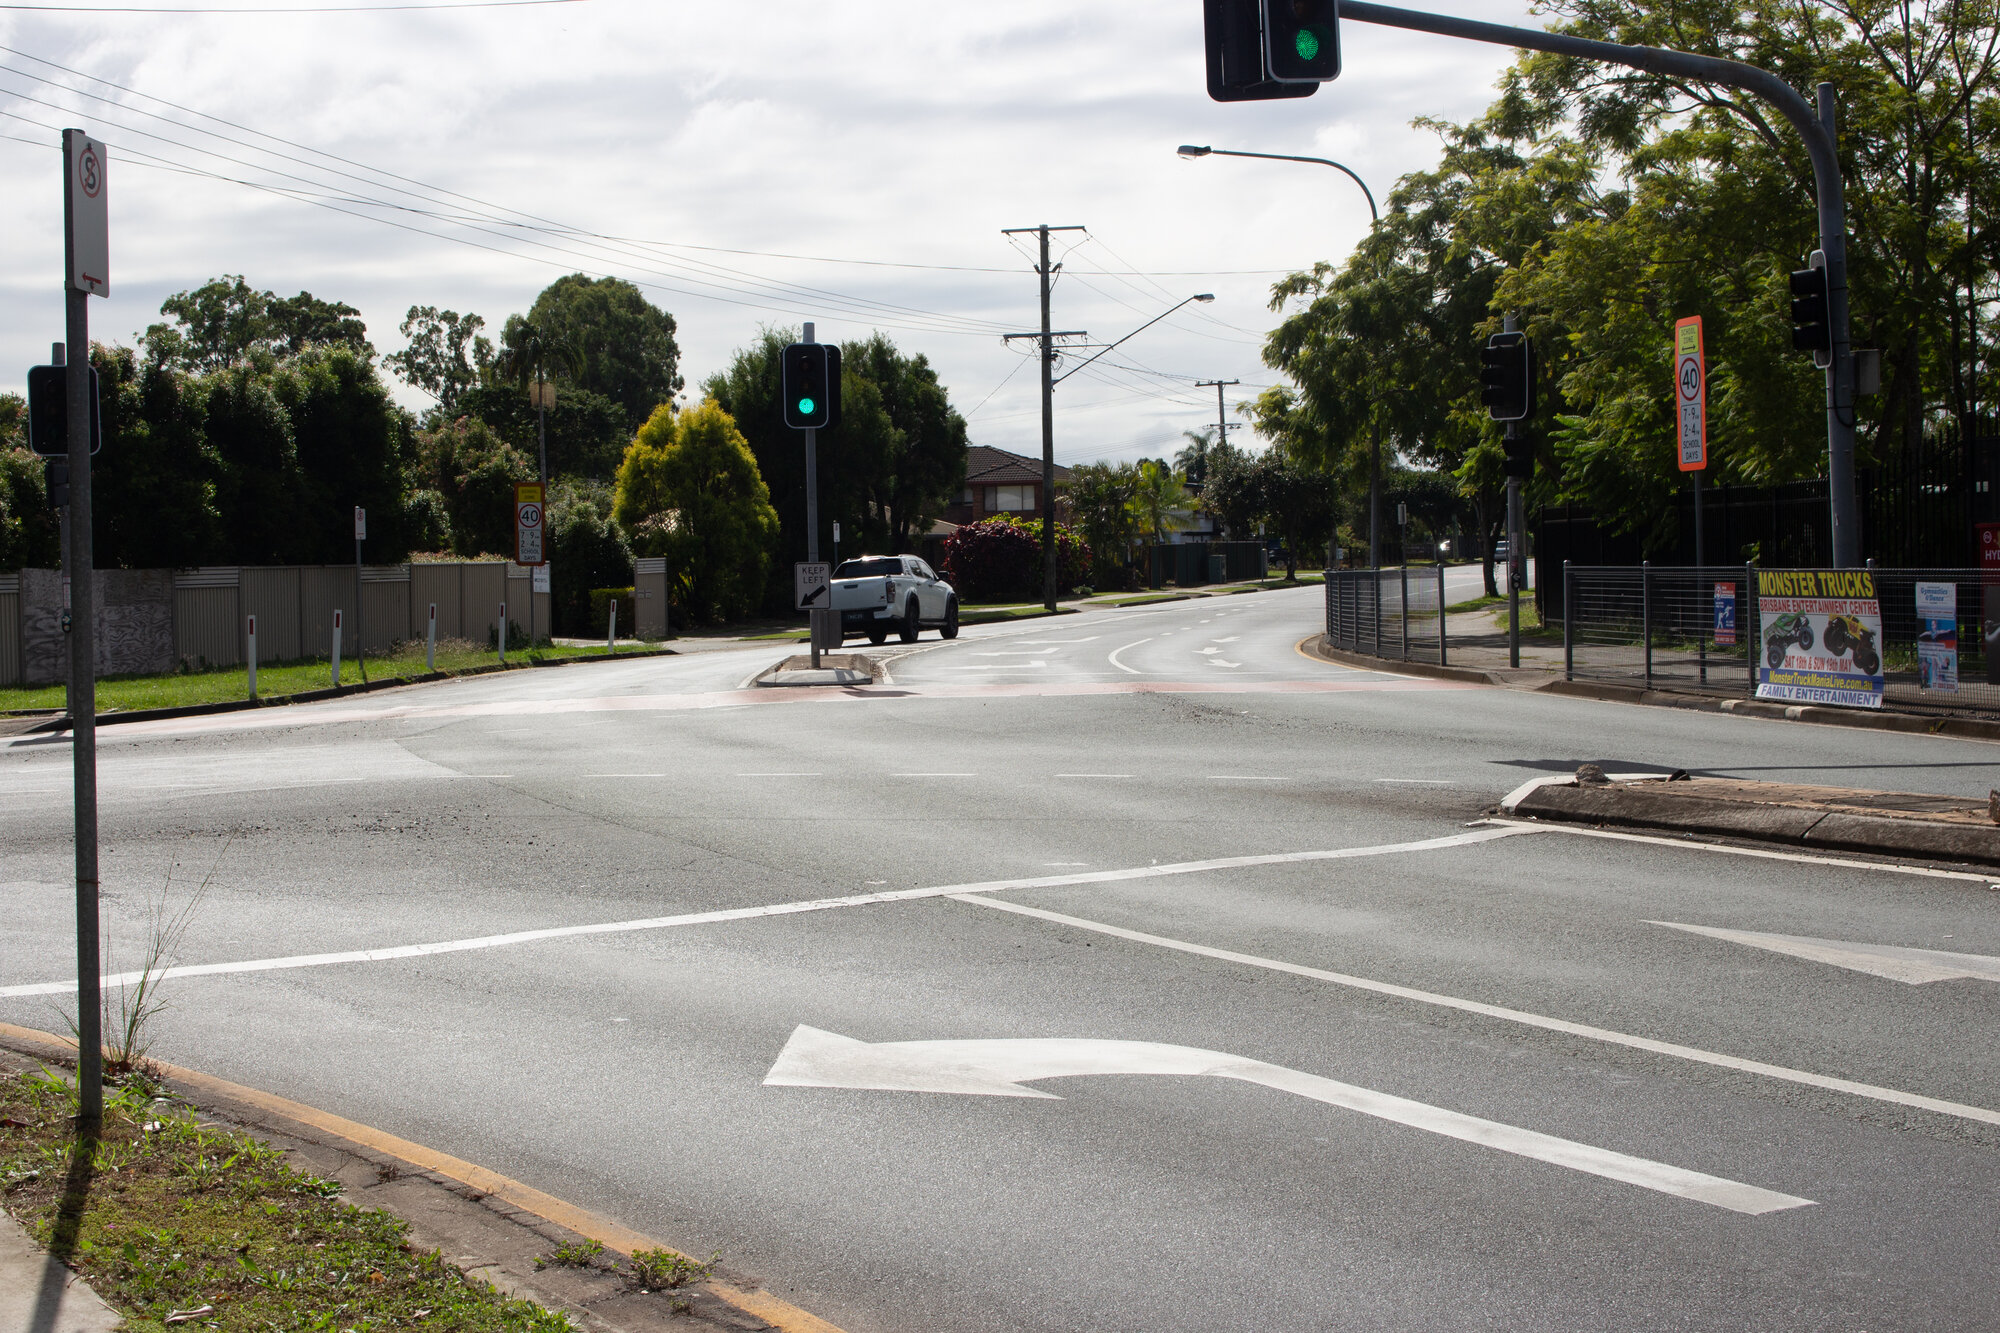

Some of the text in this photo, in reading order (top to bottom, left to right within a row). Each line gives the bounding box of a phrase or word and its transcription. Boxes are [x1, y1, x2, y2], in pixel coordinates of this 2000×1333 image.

[1682, 368, 1697, 390] 40
[1683, 440, 1700, 449] SCHOOL
[1686, 451, 1698, 460] DAYS
[521, 510, 538, 522] 40
[802, 566, 824, 575] KEEP
[803, 576, 824, 584] LEFT
[1759, 571, 1874, 597] MONSTER TRUCKS
[1760, 599, 1879, 615] BRISBANE ENTERTAINMENT CENTRE
[1784, 655, 1795, 668] SAT
[1807, 656, 1813, 669] &
[1813, 657, 1825, 670] SUN
[1839, 658, 1852, 673] MAY
[1768, 670, 1873, 691] MonsterTruckManiaLive.com.au
[1760, 685, 1879, 706] FAMILY ENTERTAINMENT
